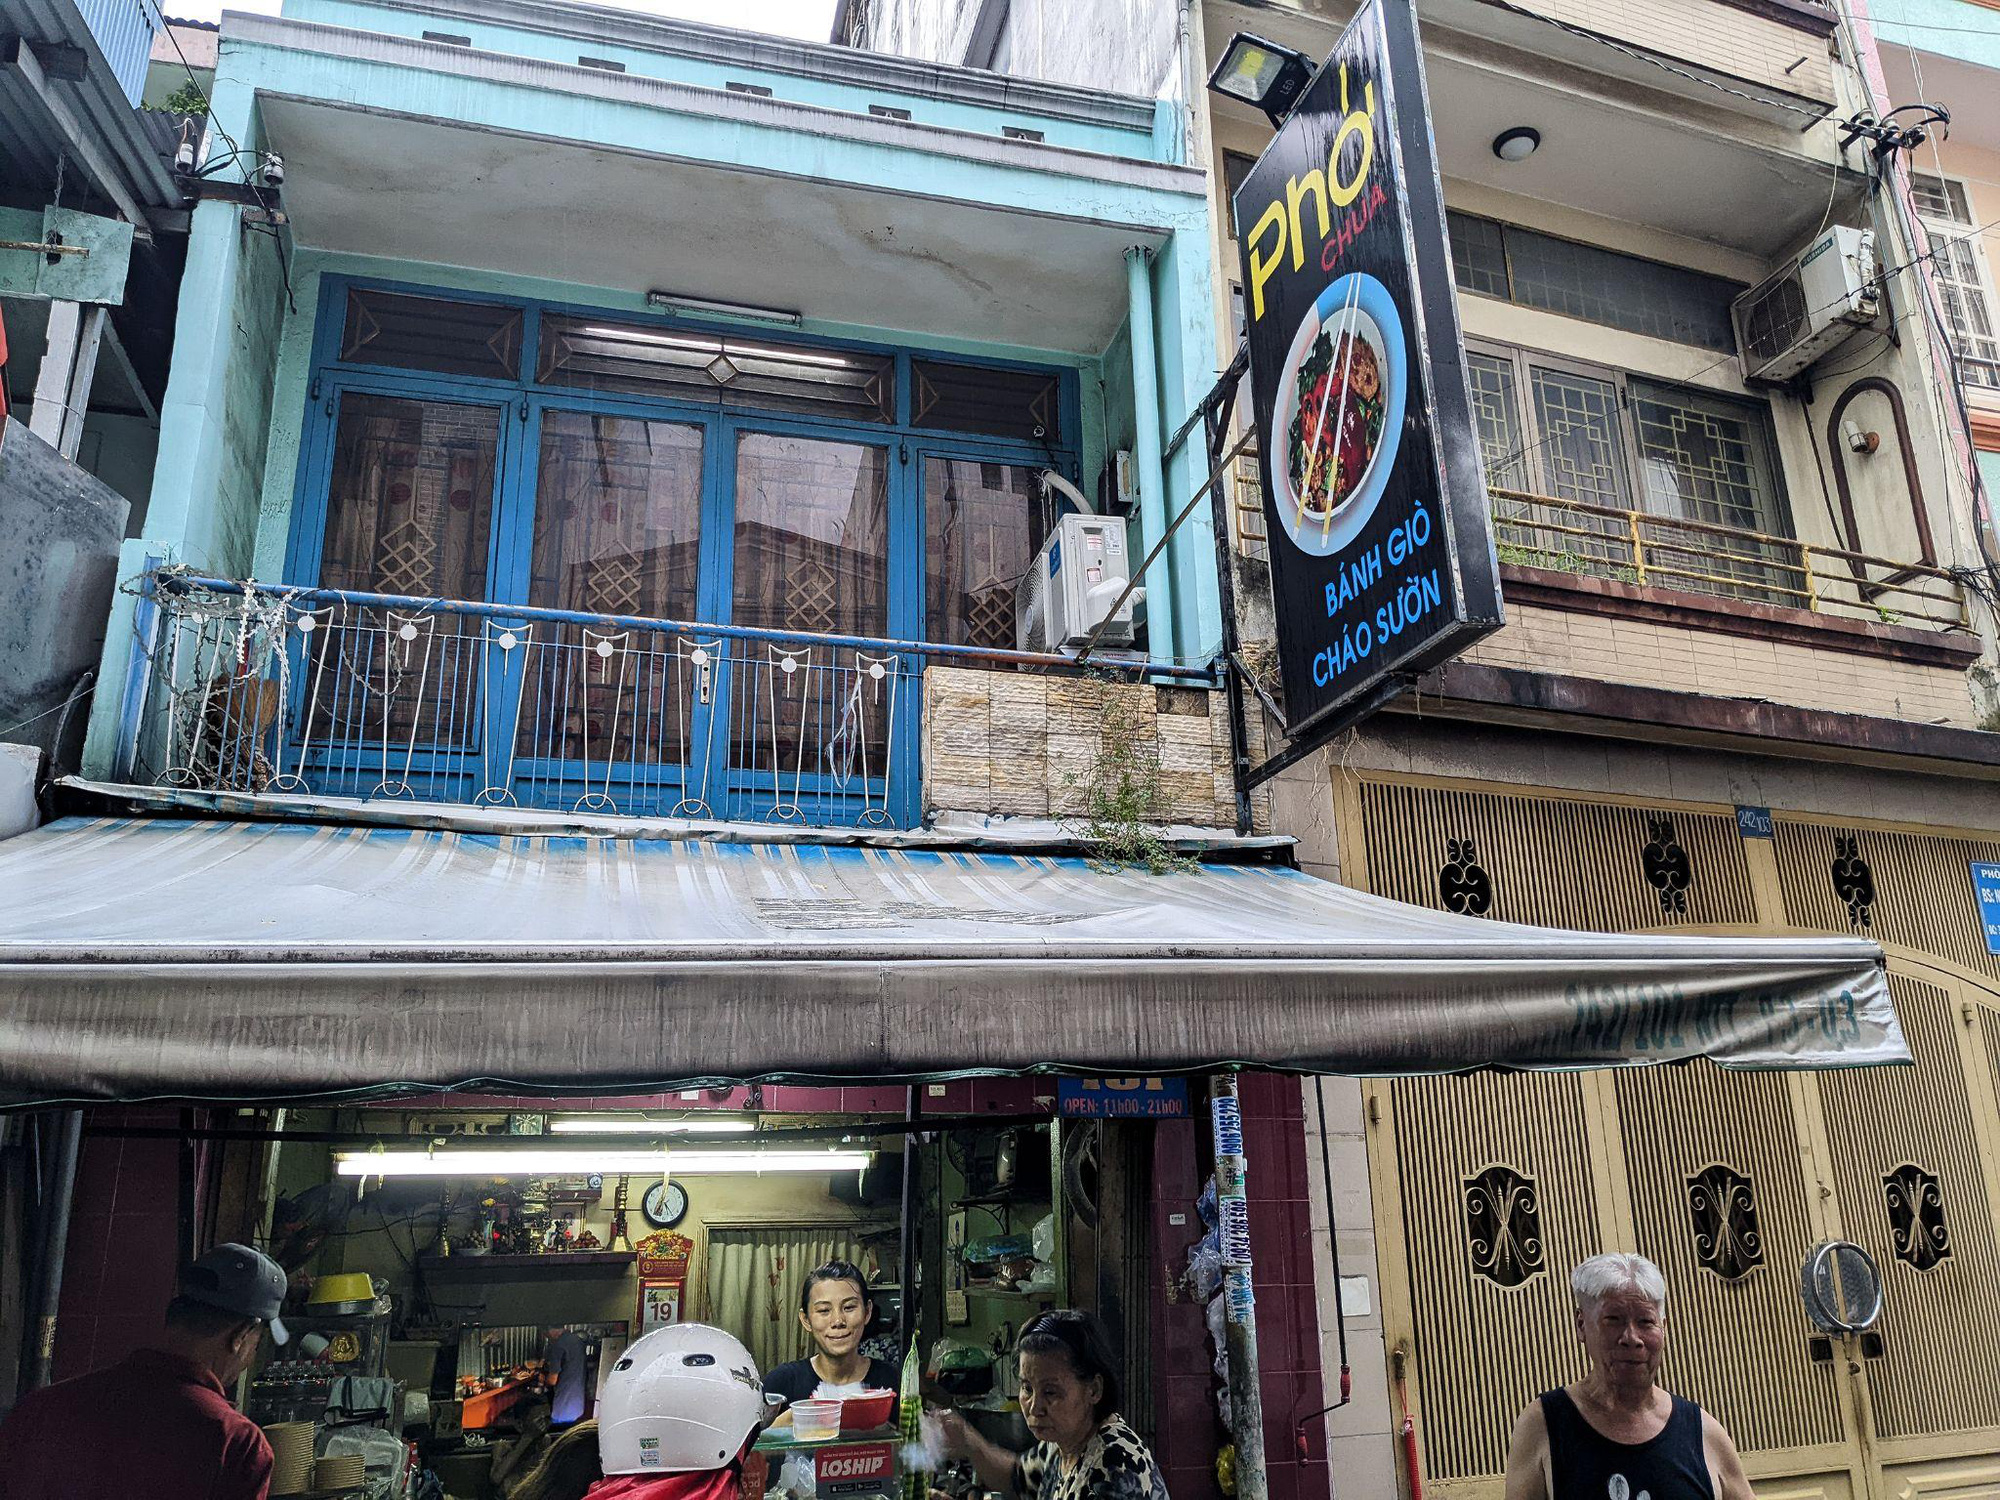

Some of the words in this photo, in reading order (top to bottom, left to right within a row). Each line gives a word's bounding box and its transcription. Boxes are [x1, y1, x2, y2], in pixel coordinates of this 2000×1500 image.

[1280, 79, 1295, 95] LED
[1325, 543, 1383, 617] BÁNH
[1387, 499, 1431, 566] GIÒ
[1312, 623, 1372, 688] CHÁO
[1376, 568, 1442, 645] SƯỜN
[1064, 1097, 1098, 1113] OPEN:
[650, 1302, 673, 1322] 19
[820, 1456, 885, 1478] LOSHIP
